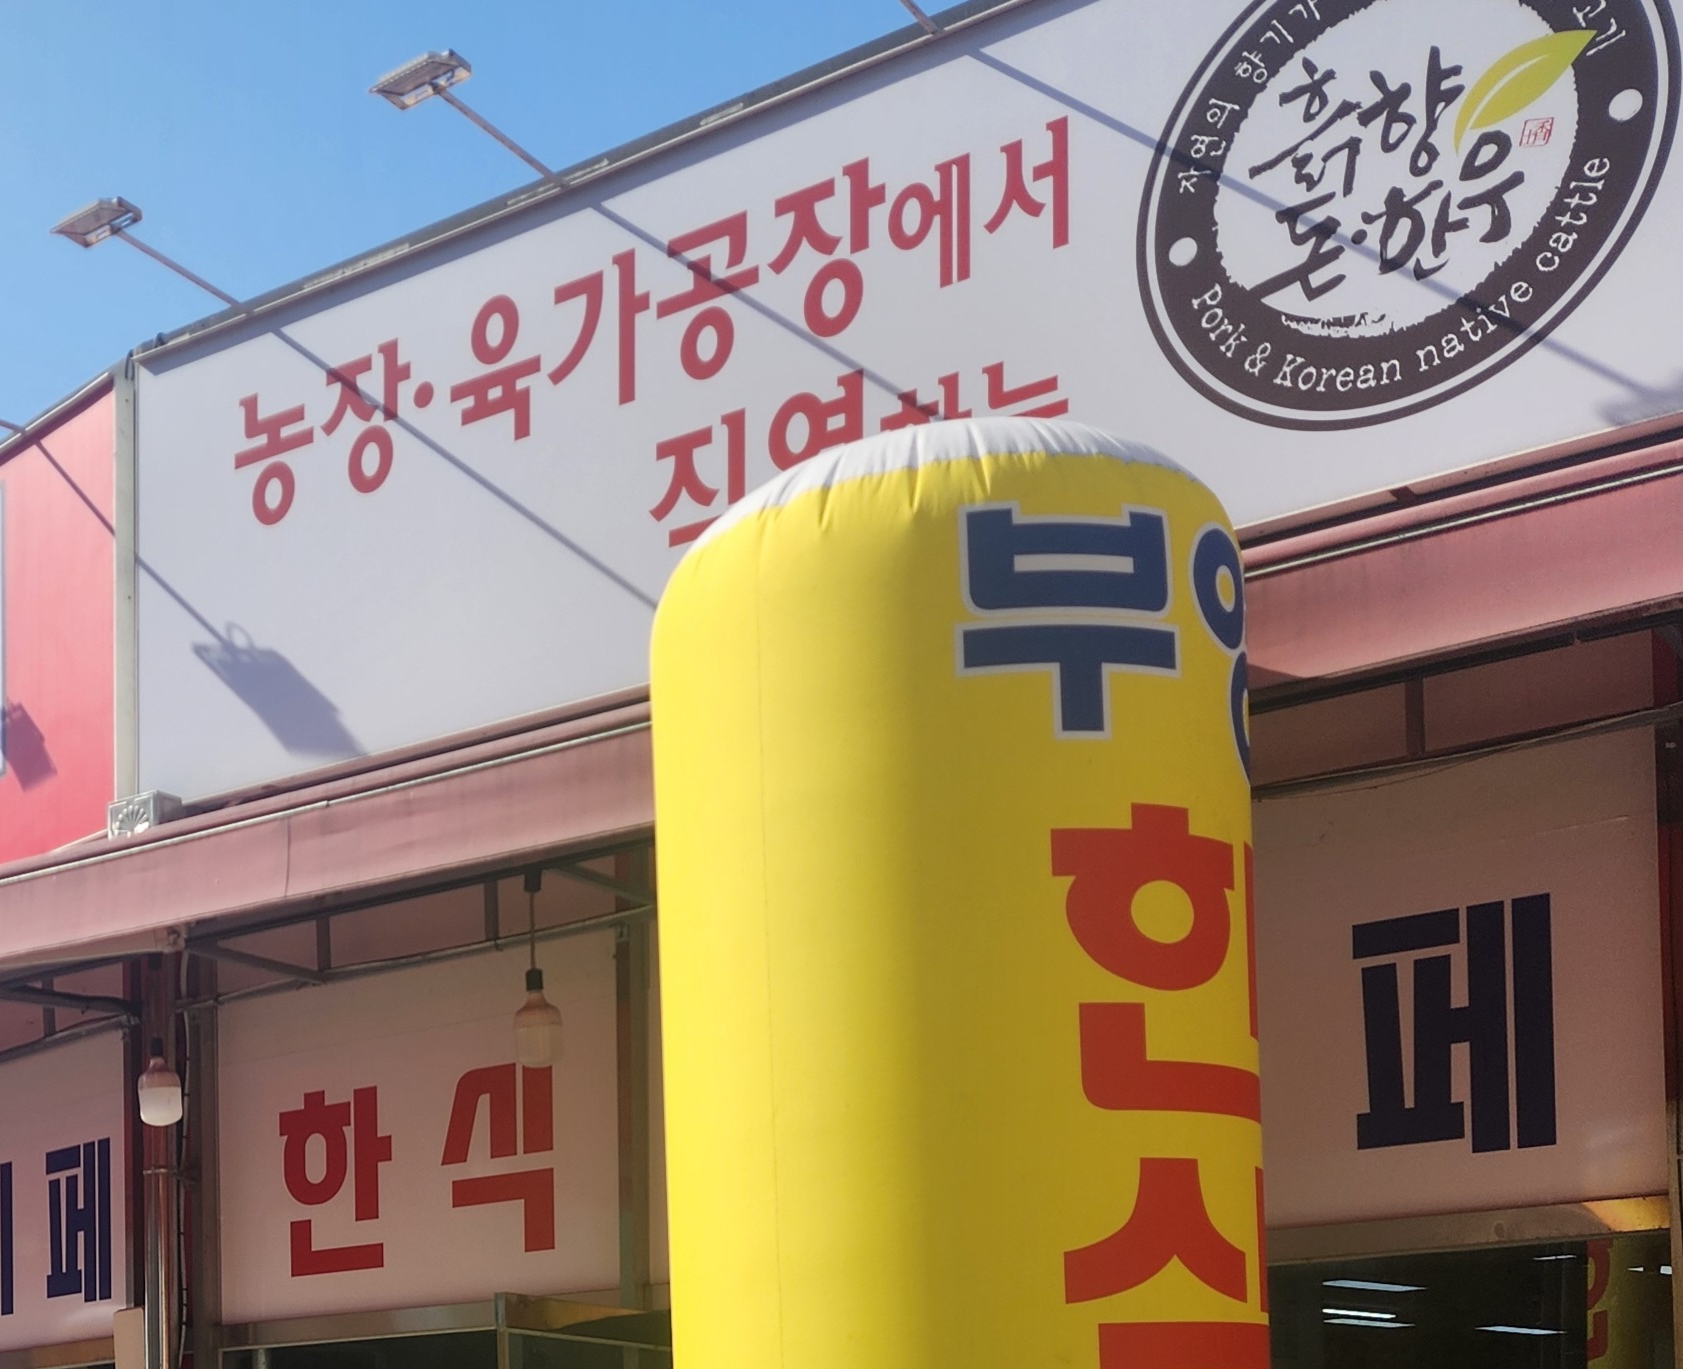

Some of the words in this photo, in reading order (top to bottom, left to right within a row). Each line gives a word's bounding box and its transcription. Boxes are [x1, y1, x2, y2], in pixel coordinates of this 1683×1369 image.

[1192, 283, 1248, 358] Pork
[1244, 343, 1273, 373] &
[1273, 354, 1403, 393] Korean
[1417, 279, 1535, 373] native
[1535, 155, 1612, 272] cattle
[278, 1060, 556, 1278] 한식
